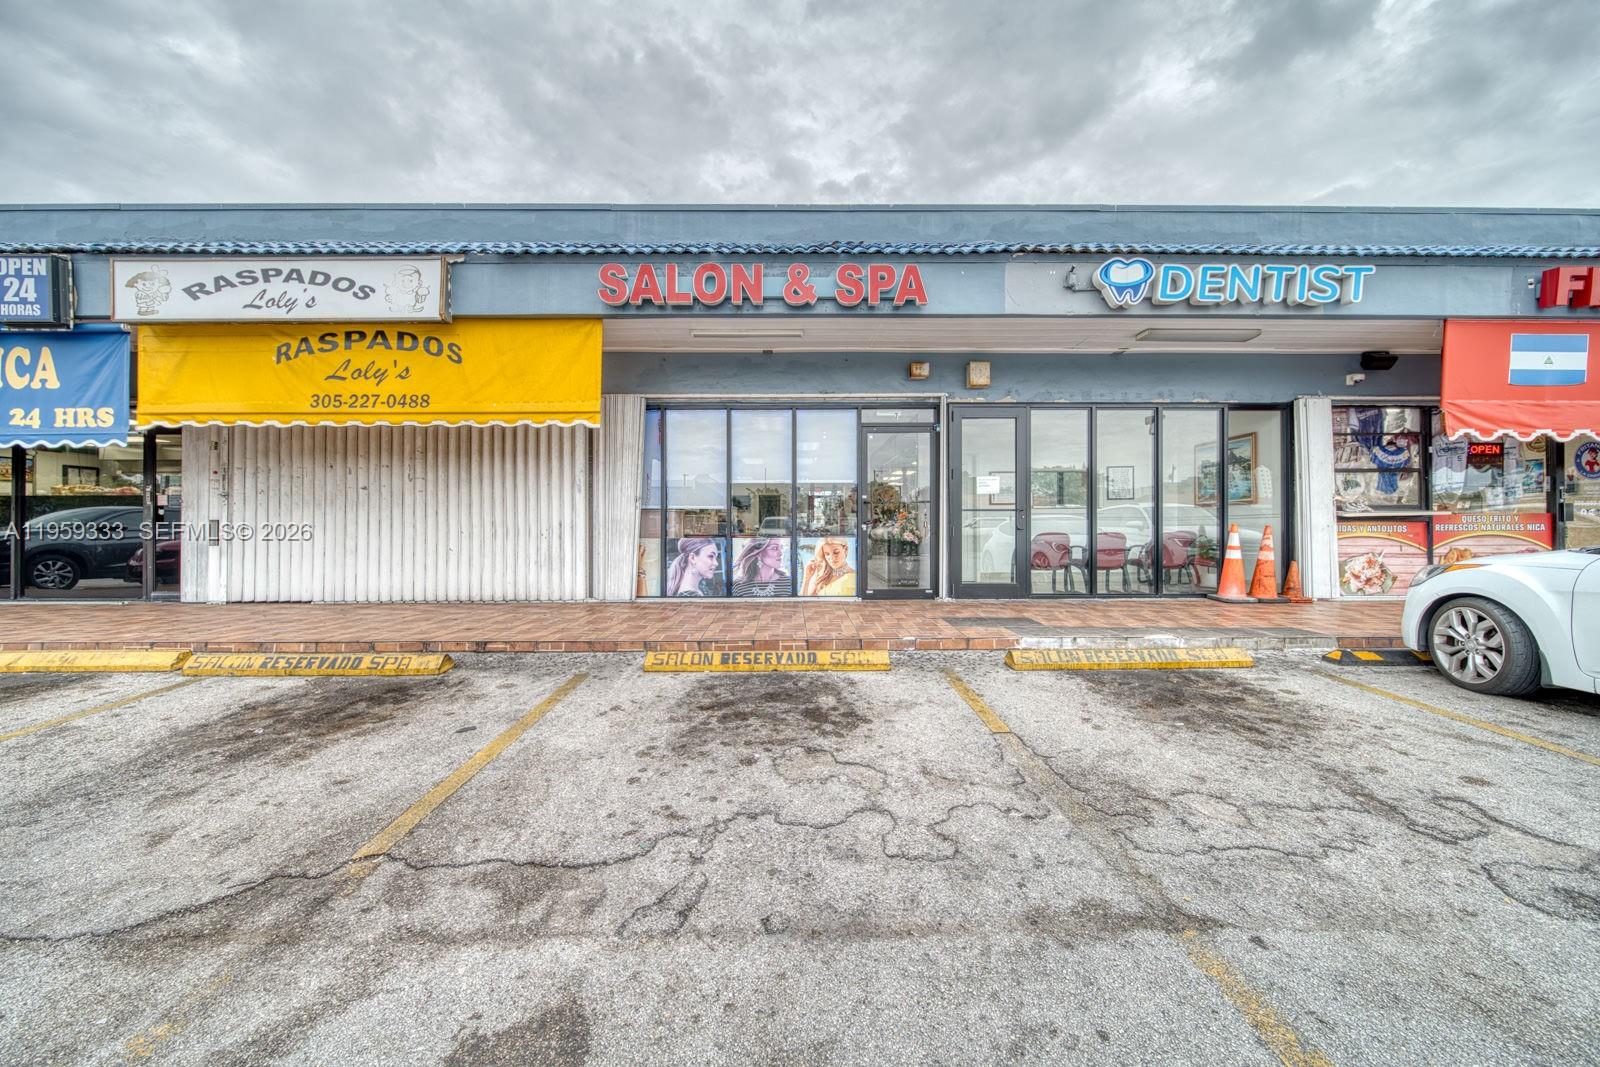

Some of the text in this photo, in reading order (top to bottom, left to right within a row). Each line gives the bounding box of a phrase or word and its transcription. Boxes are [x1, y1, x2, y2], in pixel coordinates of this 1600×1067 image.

[3, 277, 37, 302] 24
[182, 267, 376, 301] RASPADOS
[598, 262, 930, 307] SALON & SPA
[1156, 264, 1375, 304] DENTIST
[0, 304, 41, 315] HORAS
[242, 288, 318, 315] Loly's
[275, 329, 463, 365] RASPADOS
[0, 346, 61, 389] CA
[324, 358, 412, 387] Loly's
[310, 394, 430, 408] 305-227-0488
[8, 407, 115, 429] 24 HRS
[1470, 444, 1500, 454] OPEN
[1435, 523, 1546, 531] REFRESCOS NATURALES NICA
[1461, 515, 1520, 523] QUESO FRITO Y
[366, 655, 412, 669] SPA
[650, 652, 714, 666] SALON
[720, 652, 817, 665] RESERVADO
